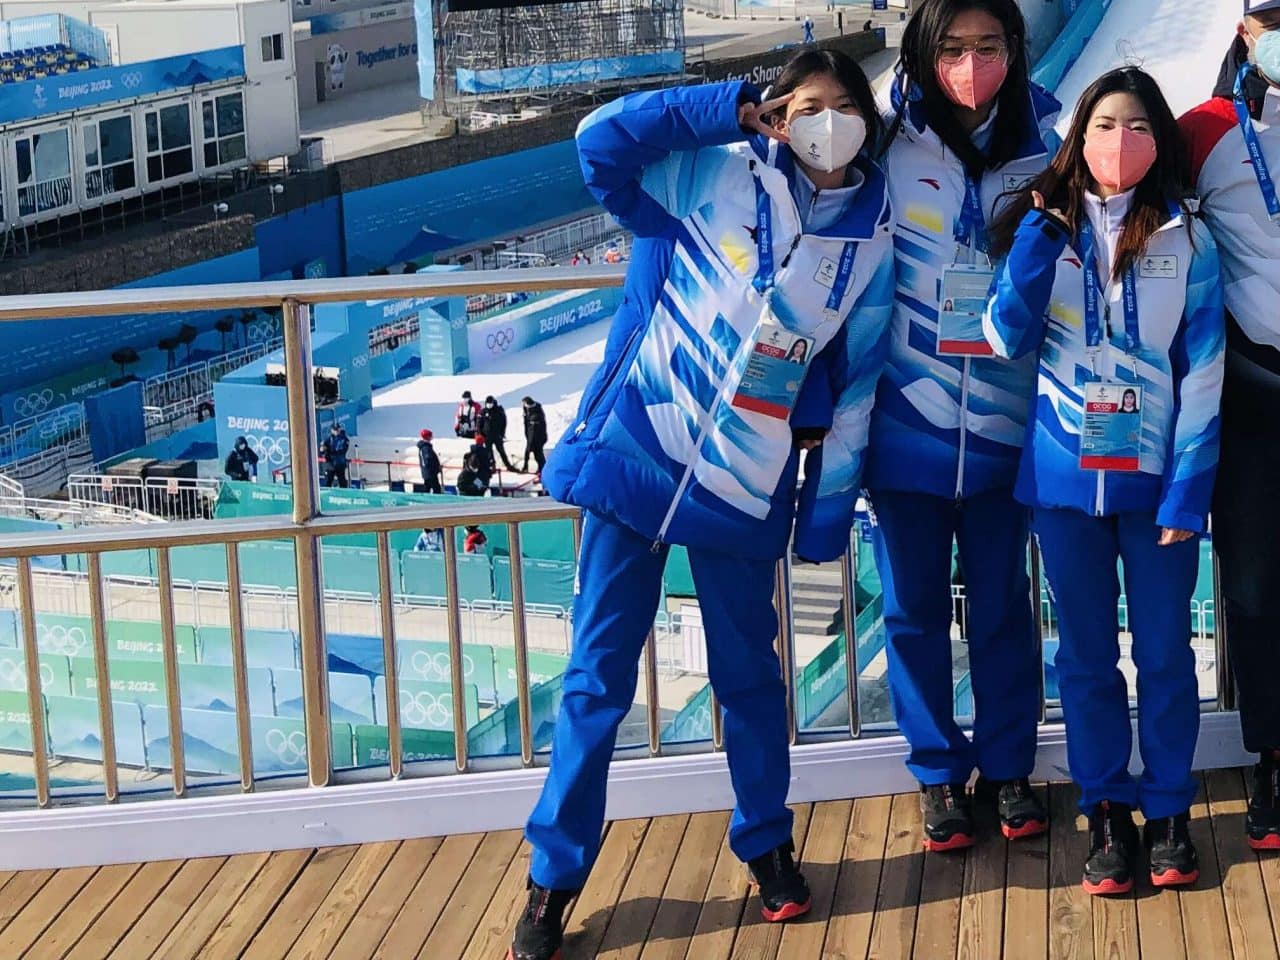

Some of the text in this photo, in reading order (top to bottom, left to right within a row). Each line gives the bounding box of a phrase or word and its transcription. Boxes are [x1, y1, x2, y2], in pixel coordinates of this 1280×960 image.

[356, 45, 397, 69] Together
[398, 42, 411, 58] for
[752, 65, 785, 85] Share
[58, 79, 113, 100] BEIJING 2022
[383, 298, 413, 318] BEIJING
[539, 299, 604, 334] BEIJING 2022
[227, 416, 289, 433] BEIJING 20
[116, 639, 154, 655] BEIJING
[127, 680, 161, 692] 2022
